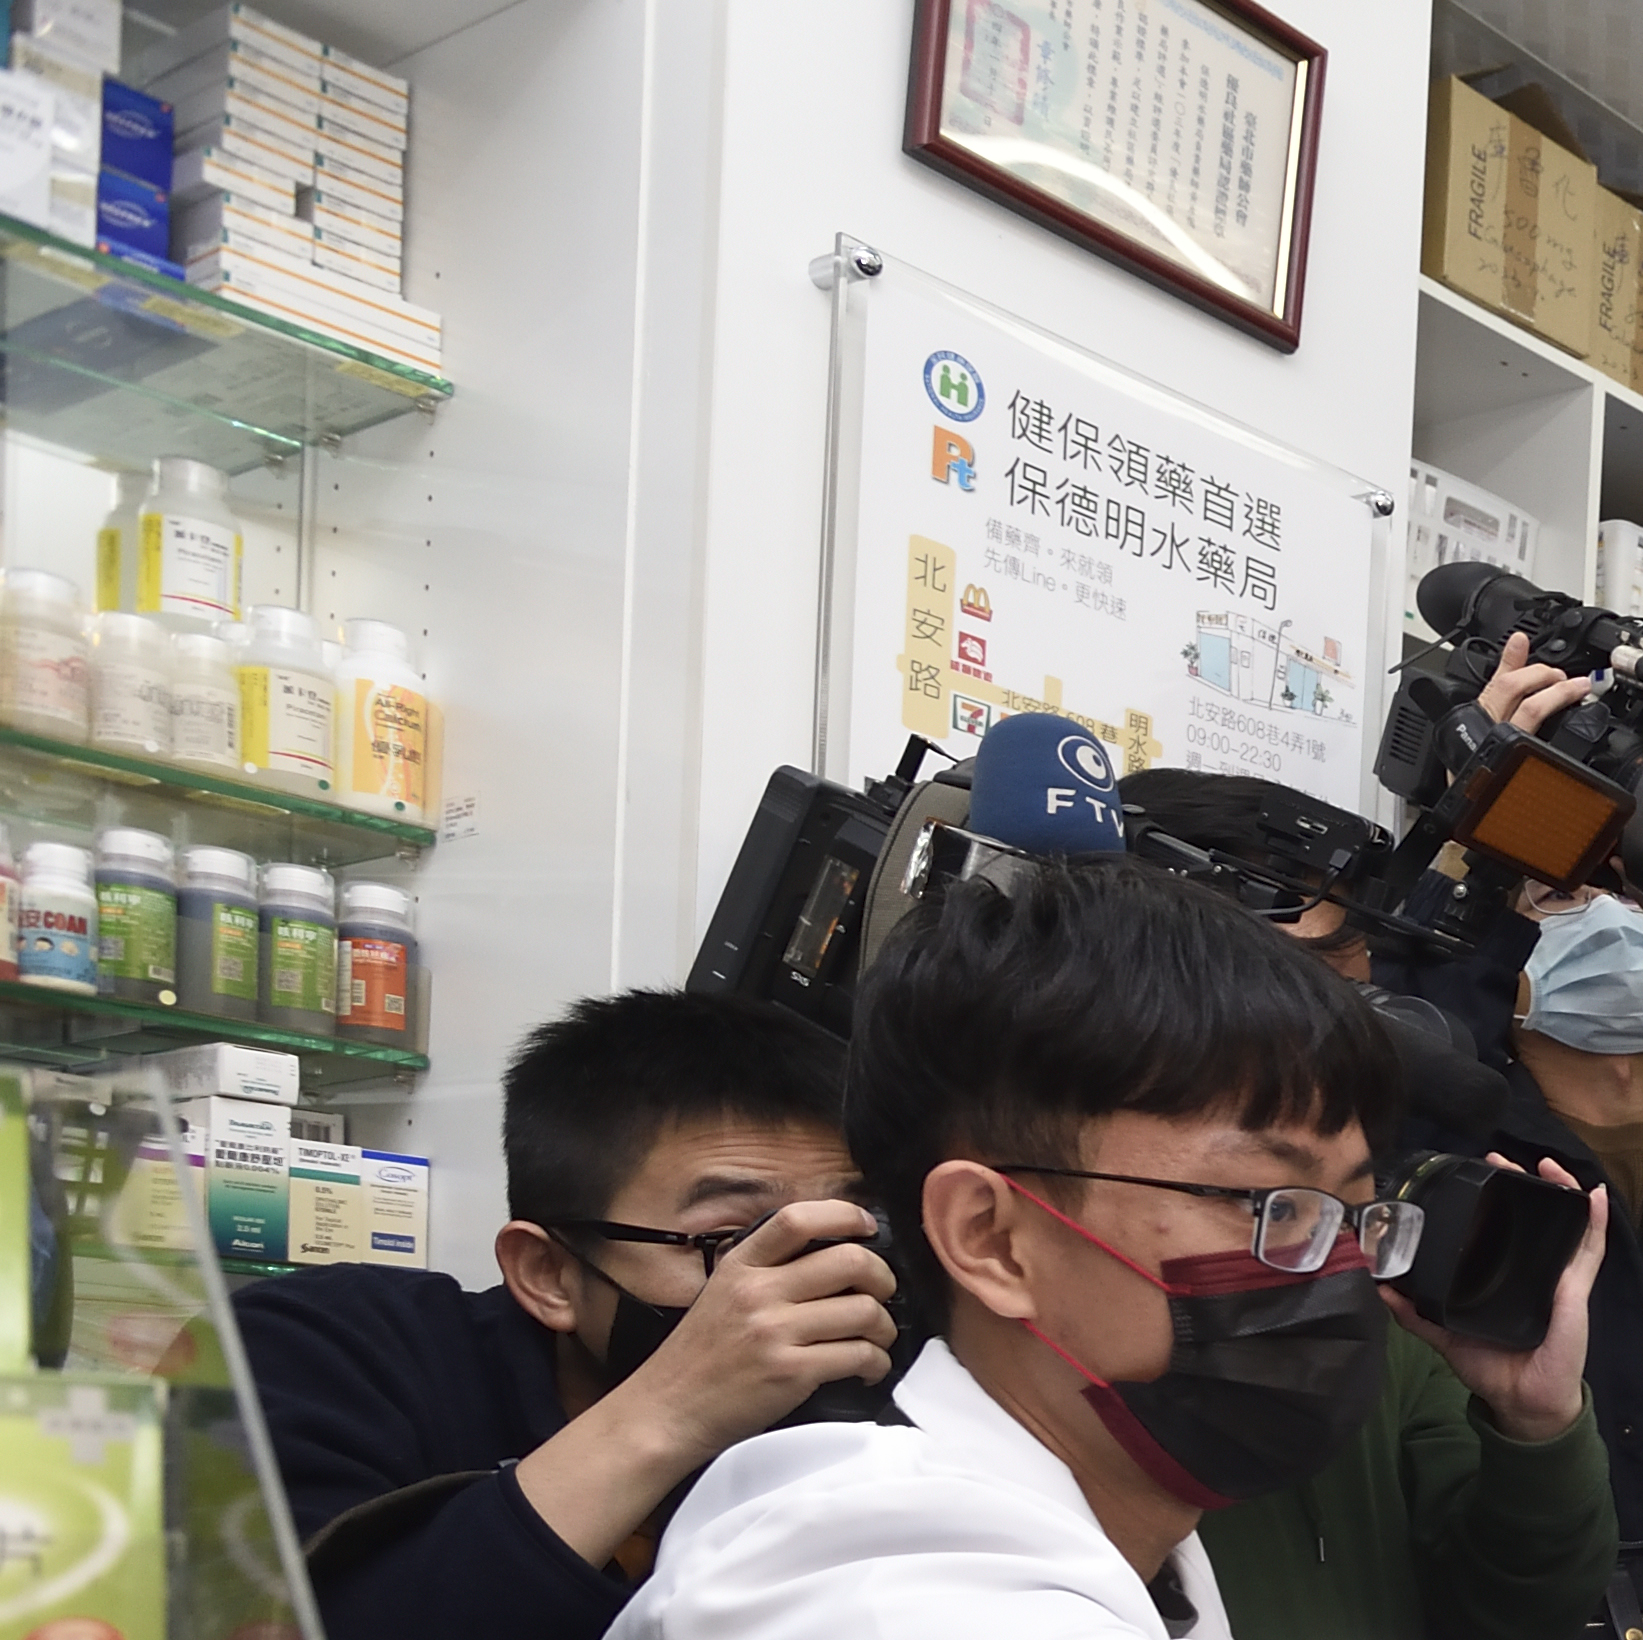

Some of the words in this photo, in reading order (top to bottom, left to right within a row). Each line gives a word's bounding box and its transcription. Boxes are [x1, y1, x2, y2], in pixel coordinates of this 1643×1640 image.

[1468, 143, 1488, 242] FRAGILE
[1600, 242, 1618, 332] FRAGILE
[1006, 388, 1283, 552] 健保領藥首選
[1003, 456, 1279, 611] 保德明水藥局
[908, 552, 947, 700] 北安路
[1099, 722, 1119, 745] 巷
[1185, 723, 1282, 772] 09:00-22:30
[1188, 695, 1327, 763] 北安路608巷4弄1號
[1046, 787, 1125, 839] FTV
[43, 912, 88, 935] COAN
